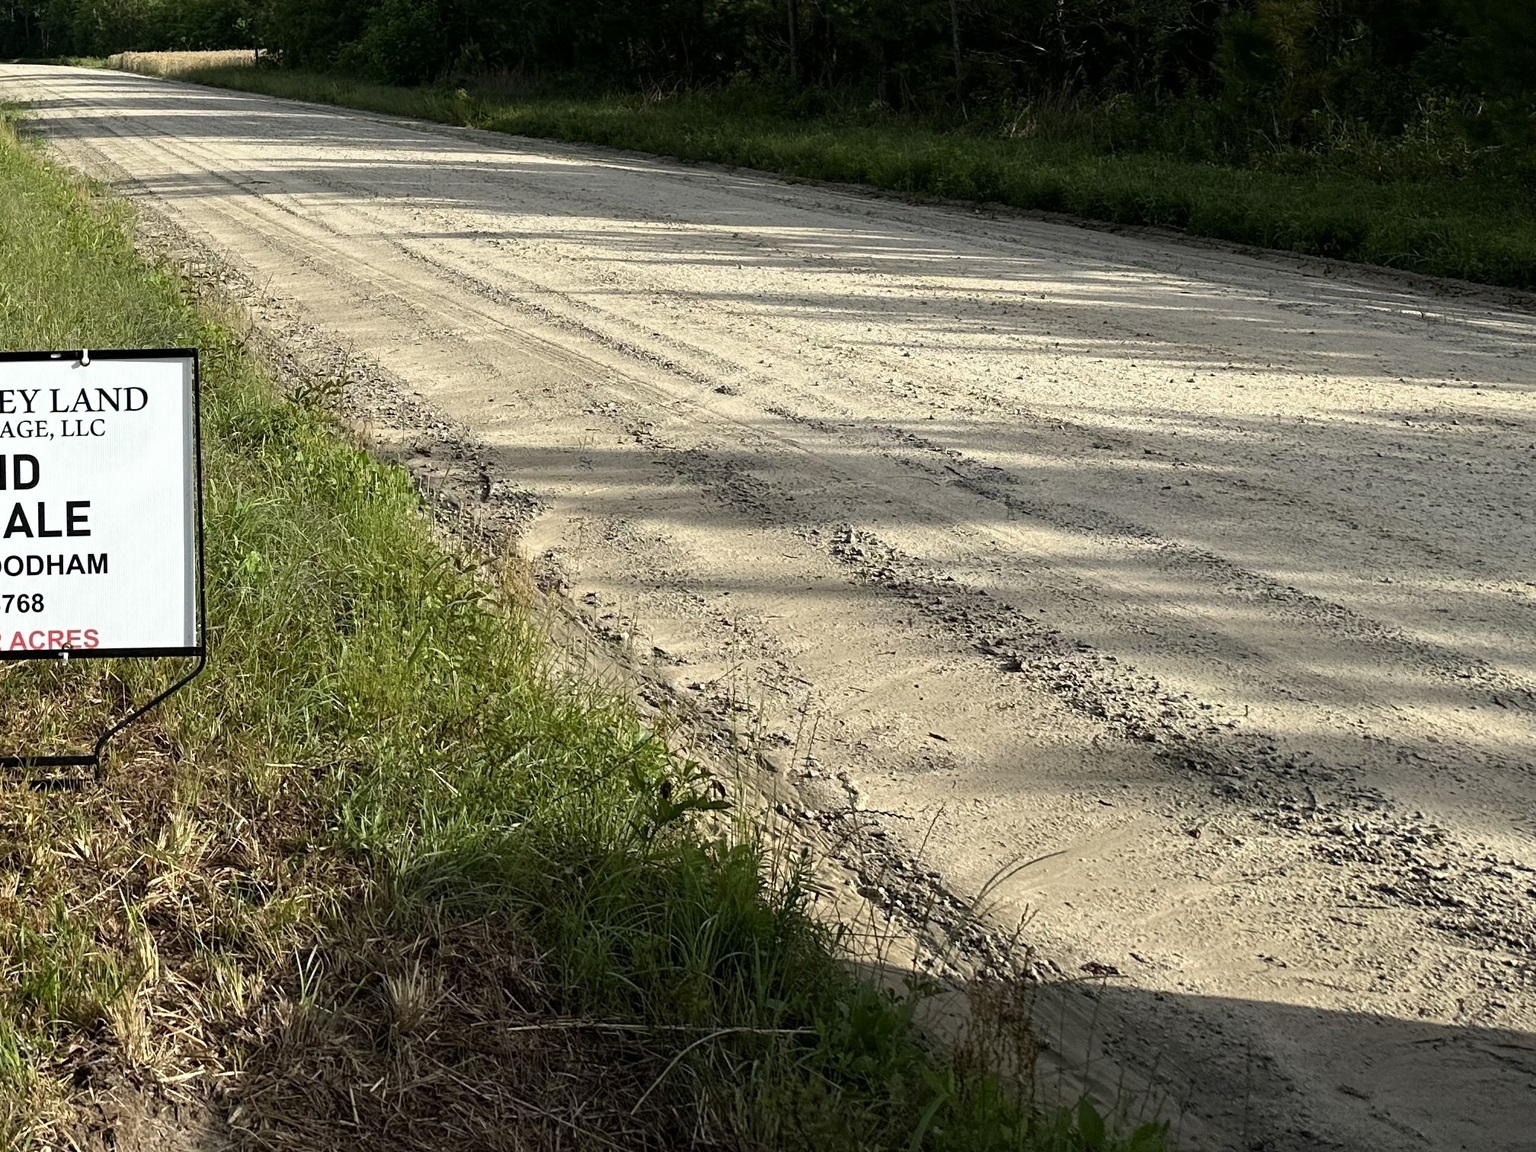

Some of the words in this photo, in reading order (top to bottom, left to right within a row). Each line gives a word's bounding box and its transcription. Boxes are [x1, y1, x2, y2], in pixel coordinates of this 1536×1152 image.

[49, 386, 149, 414] LAND
[61, 419, 106, 438] LLC
[9, 628, 100, 651] ACRES
